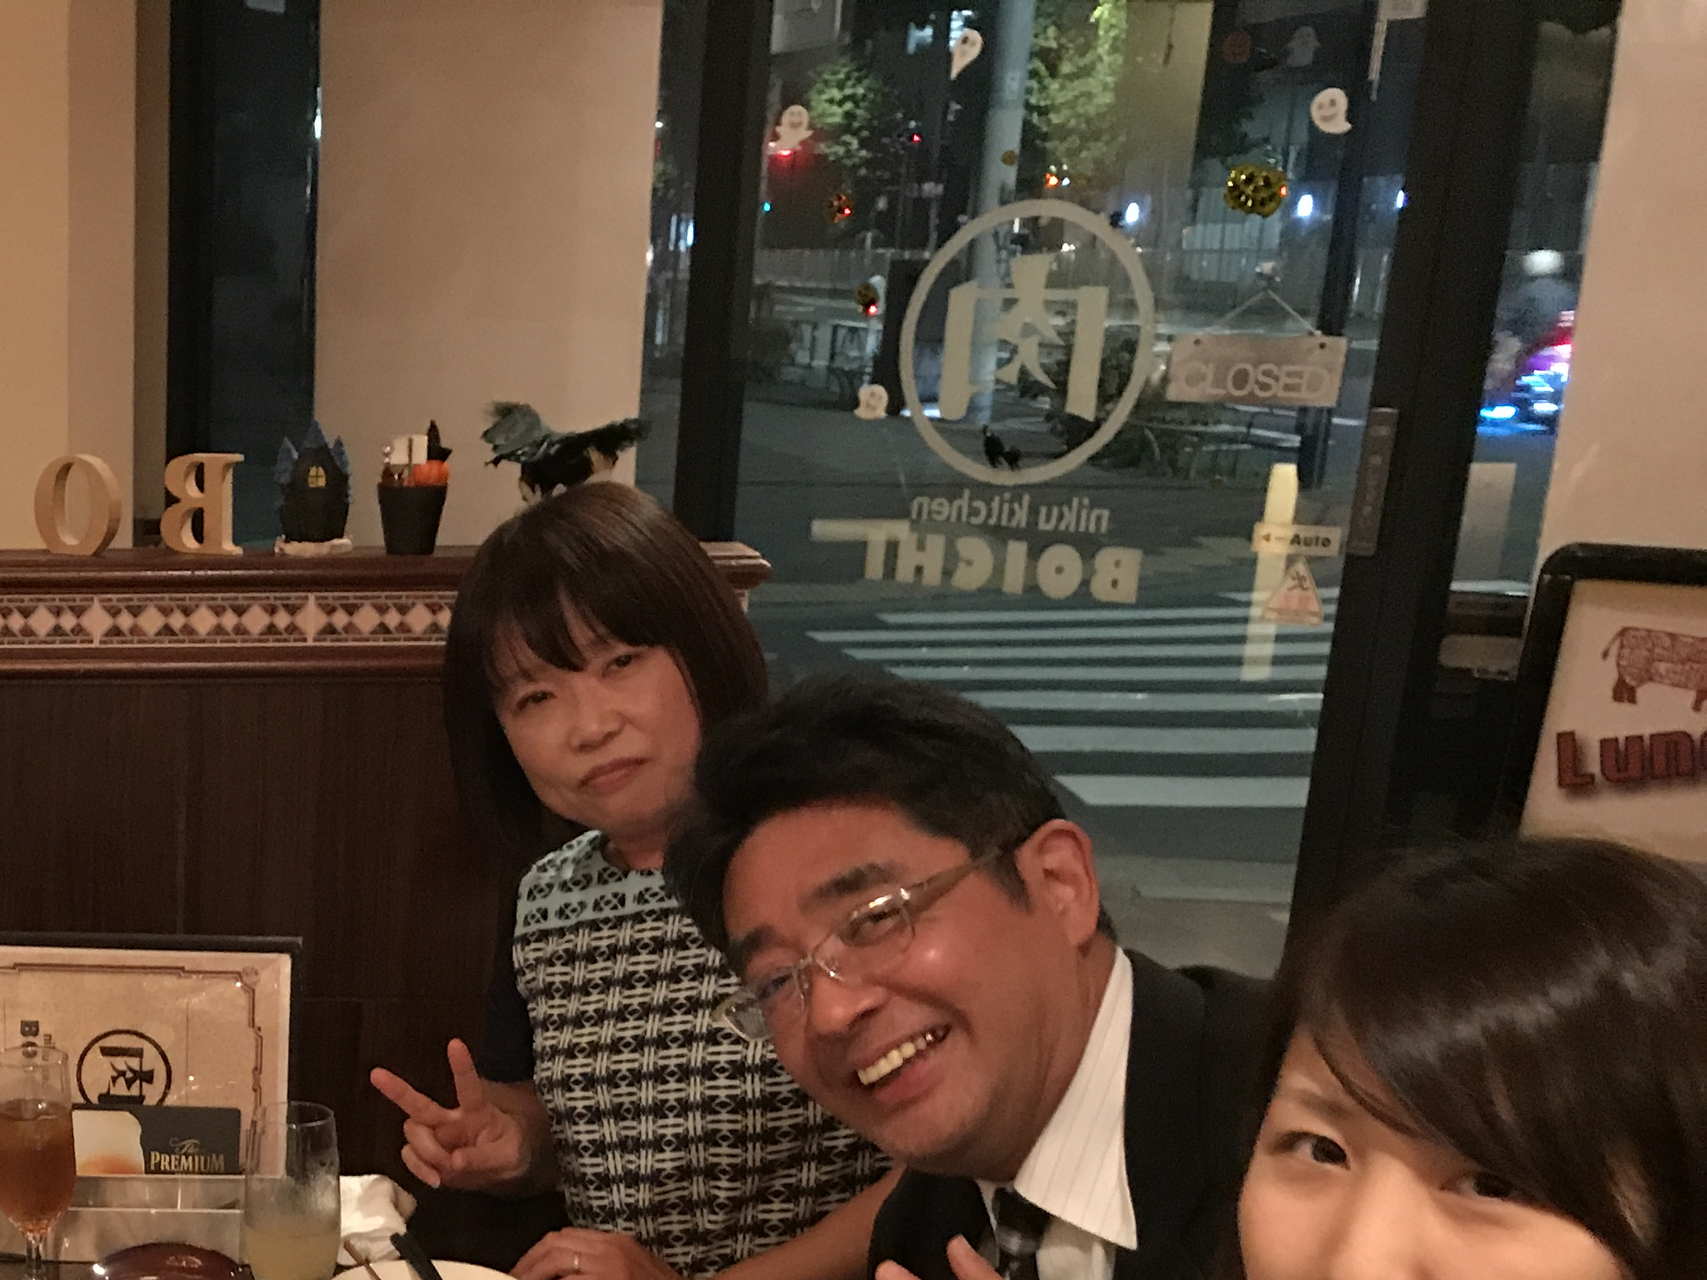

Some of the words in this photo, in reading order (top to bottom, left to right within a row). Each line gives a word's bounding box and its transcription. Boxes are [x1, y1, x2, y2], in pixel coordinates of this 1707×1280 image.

[1182, 360, 1331, 399] CLOSED
[1290, 533, 1332, 548] Auto
[1556, 730, 1707, 790] Lun
[150, 1150, 225, 1173] PREMIUM
